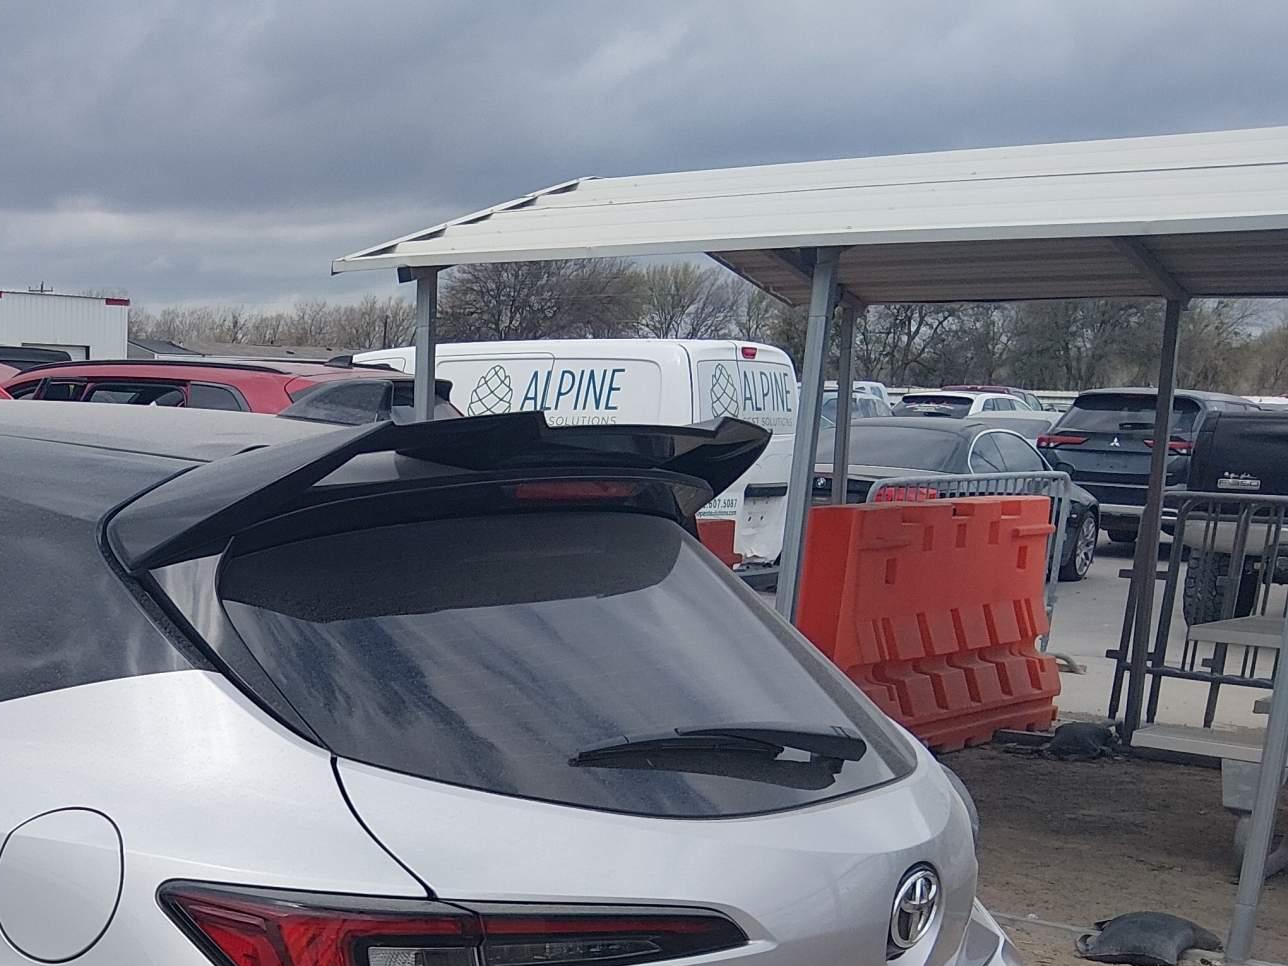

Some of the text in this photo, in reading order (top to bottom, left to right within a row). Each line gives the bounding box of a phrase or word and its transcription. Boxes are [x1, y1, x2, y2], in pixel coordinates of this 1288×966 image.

[519, 368, 626, 411] ALPINE
[743, 370, 792, 412] ALPINE
[548, 415, 617, 426] SOLUTIONS
